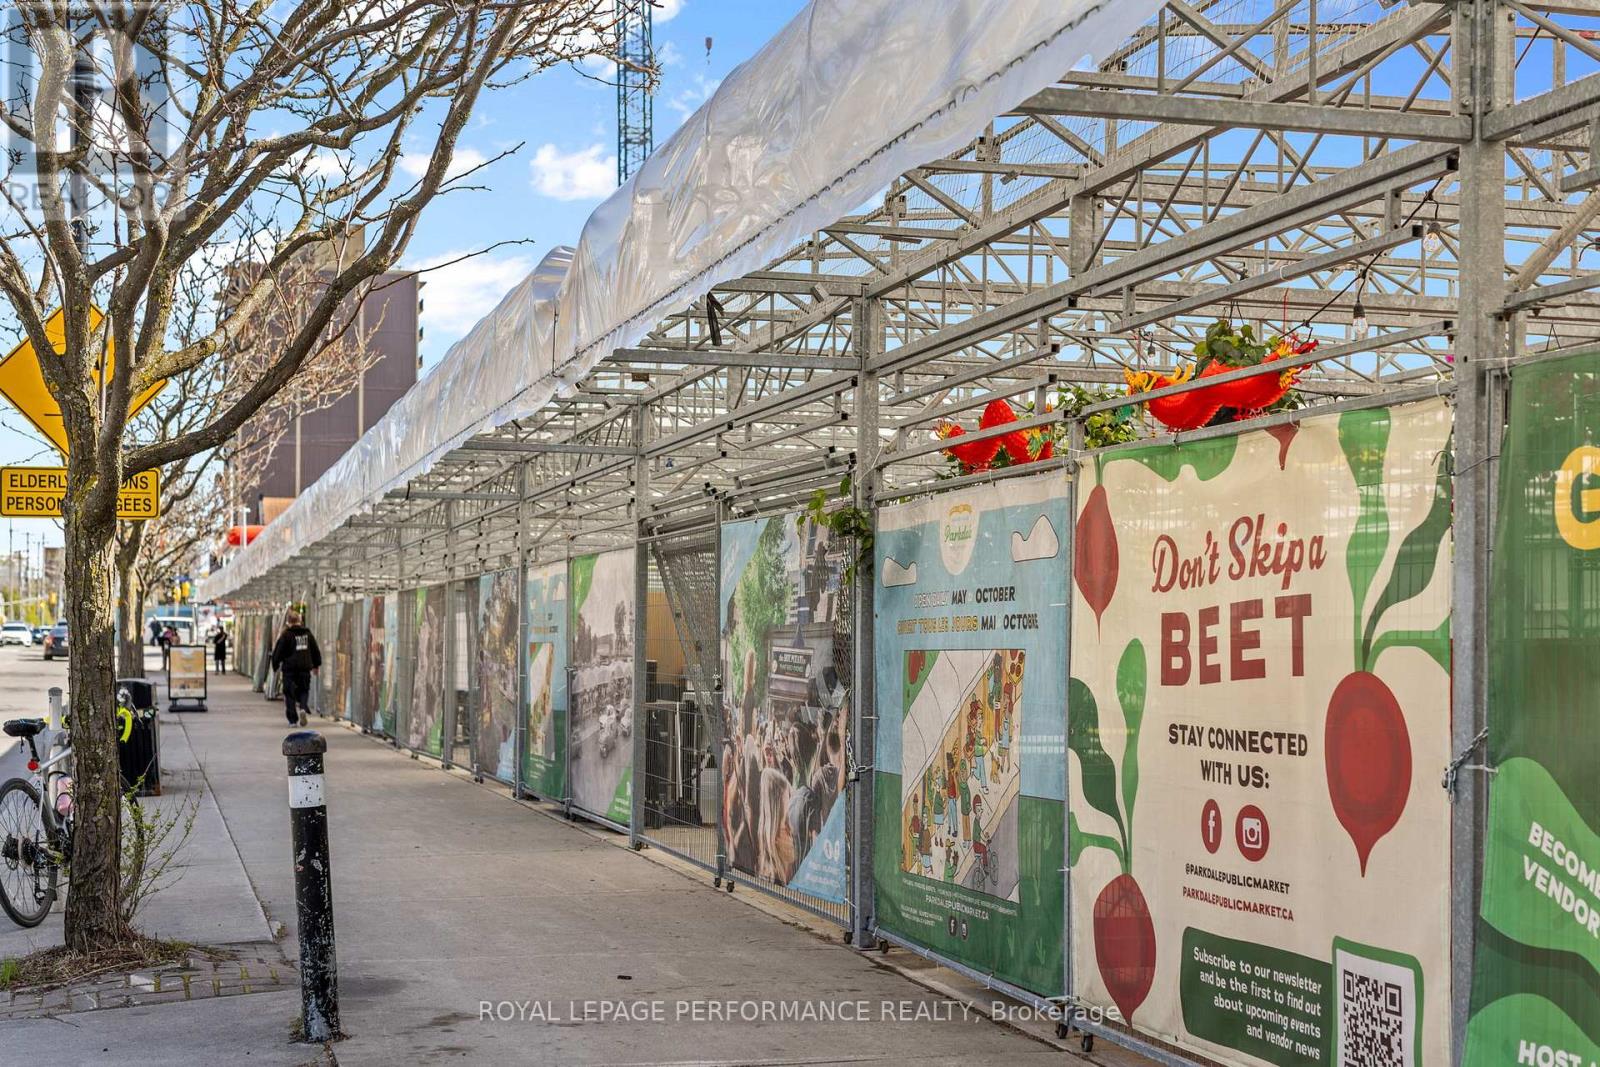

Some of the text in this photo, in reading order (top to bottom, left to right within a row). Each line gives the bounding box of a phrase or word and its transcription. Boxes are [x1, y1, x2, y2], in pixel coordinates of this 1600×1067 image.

[1152, 513, 1327, 593] Don't Skip a
[951, 589, 967, 605] MAY
[975, 586, 1016, 603] OCTOBER
[981, 615, 996, 630] MAI
[1161, 593, 1312, 686] BEET
[1168, 723, 1308, 757] STAY CONNECTED
[1200, 760, 1270, 789] WITH US:
[1185, 863, 1290, 895] @PARKDALEPUBLICMARKET
[1182, 886, 1295, 922] PARKDALEPUBLICMARKET.CA
[1193, 946, 1322, 995] Subscribe to our newsletter
[1200, 970, 1322, 1017] and be the first to find out
[1213, 993, 1321, 1038] about upcoming events
[1247, 1023, 1321, 1060] and vendor news
